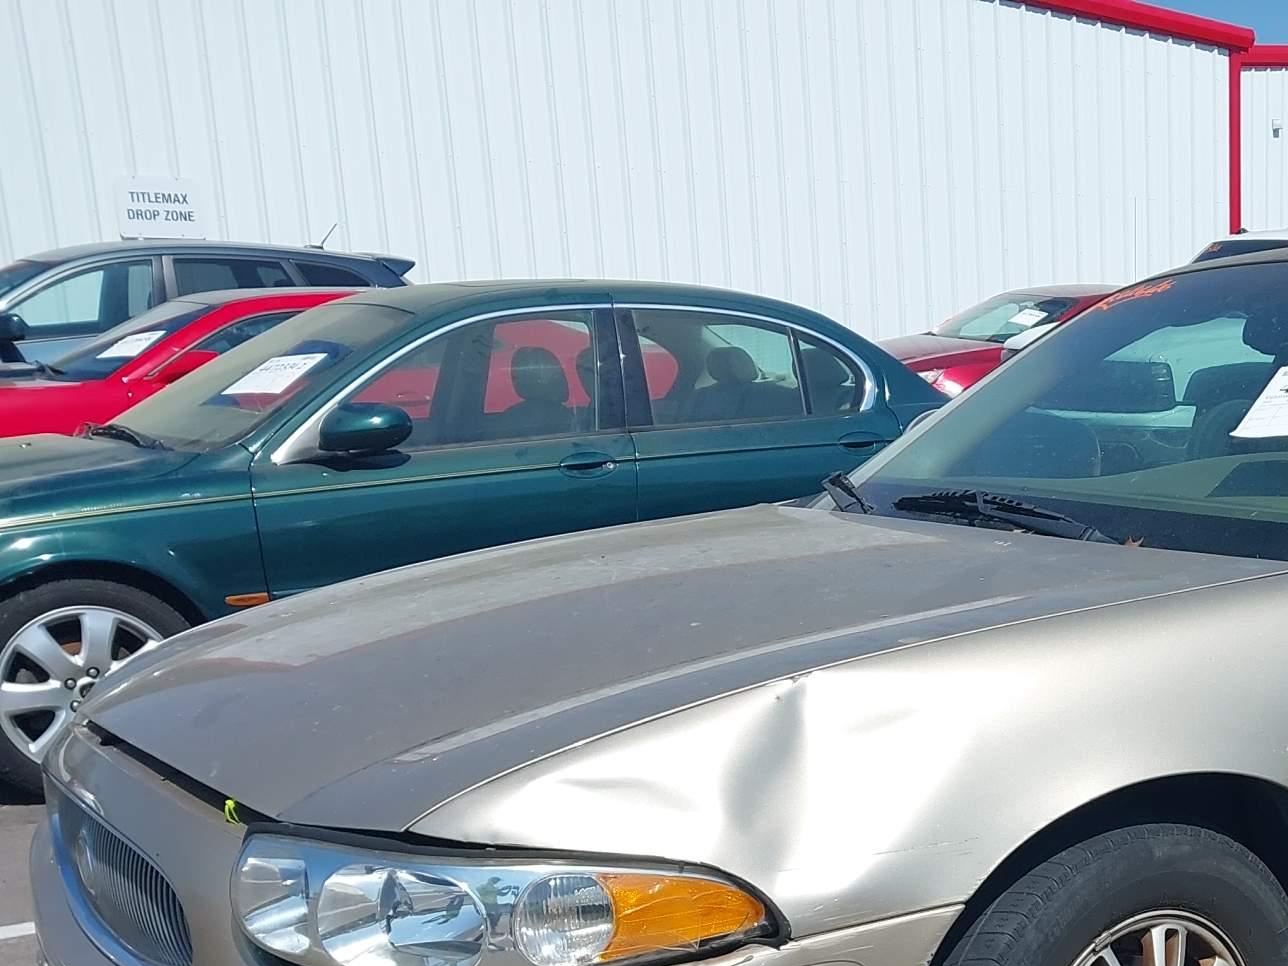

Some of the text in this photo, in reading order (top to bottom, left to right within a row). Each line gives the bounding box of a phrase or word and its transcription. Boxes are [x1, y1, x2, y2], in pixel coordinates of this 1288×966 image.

[128, 191, 190, 205] TITLEMAX
[127, 208, 196, 222] DROP ZONE
